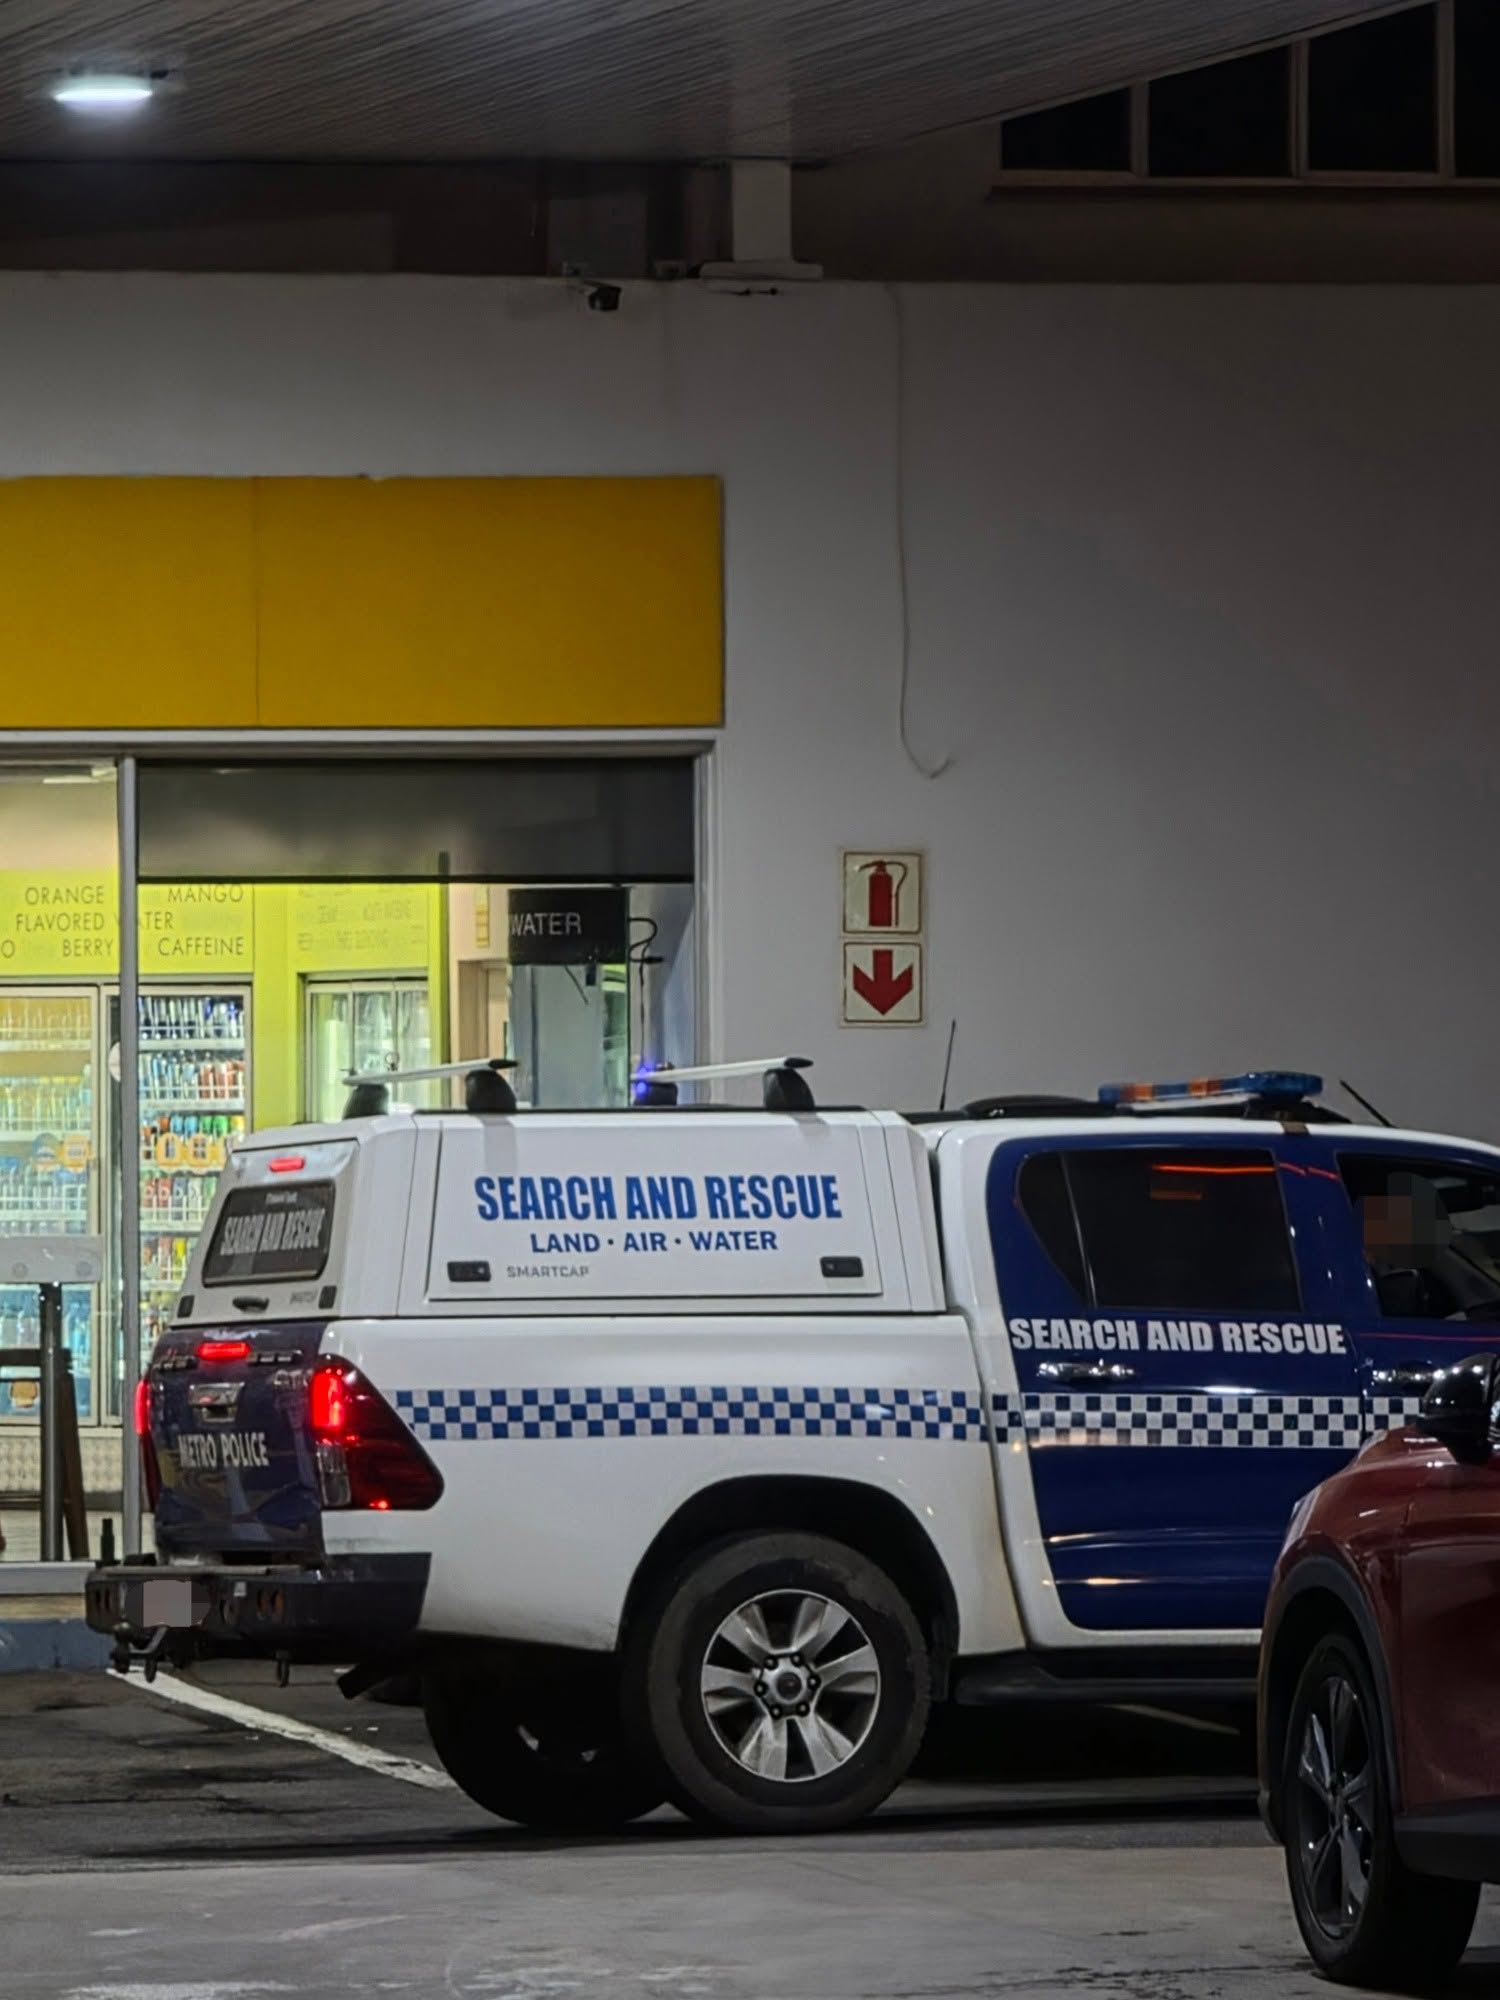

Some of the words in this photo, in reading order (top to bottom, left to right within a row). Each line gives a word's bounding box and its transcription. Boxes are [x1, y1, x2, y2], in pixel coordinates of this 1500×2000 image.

[24, 885, 105, 905] ORANGE
[168, 884, 244, 903] MANGO
[15, 912, 105, 932] FLAVORED
[113, 911, 174, 931] TER
[510, 911, 582, 936] WATER
[62, 938, 113, 957] BERRY
[158, 936, 244, 956] CAFFEINE
[474, 1175, 618, 1222] SEARCH
[624, 1175, 698, 1221] AND
[705, 1174, 843, 1220] RESCUE
[530, 1233, 600, 1253] LAND
[623, 1232, 668, 1251] AIR
[689, 1231, 778, 1251] WATER
[506, 1265, 590, 1278] SMARTCAP
[1009, 1318, 1139, 1350] SEARCH
[1147, 1321, 1213, 1352] AND
[1219, 1322, 1347, 1355] RESCUE
[178, 1434, 218, 1467] METRO
[220, 1432, 270, 1467] POLICE
